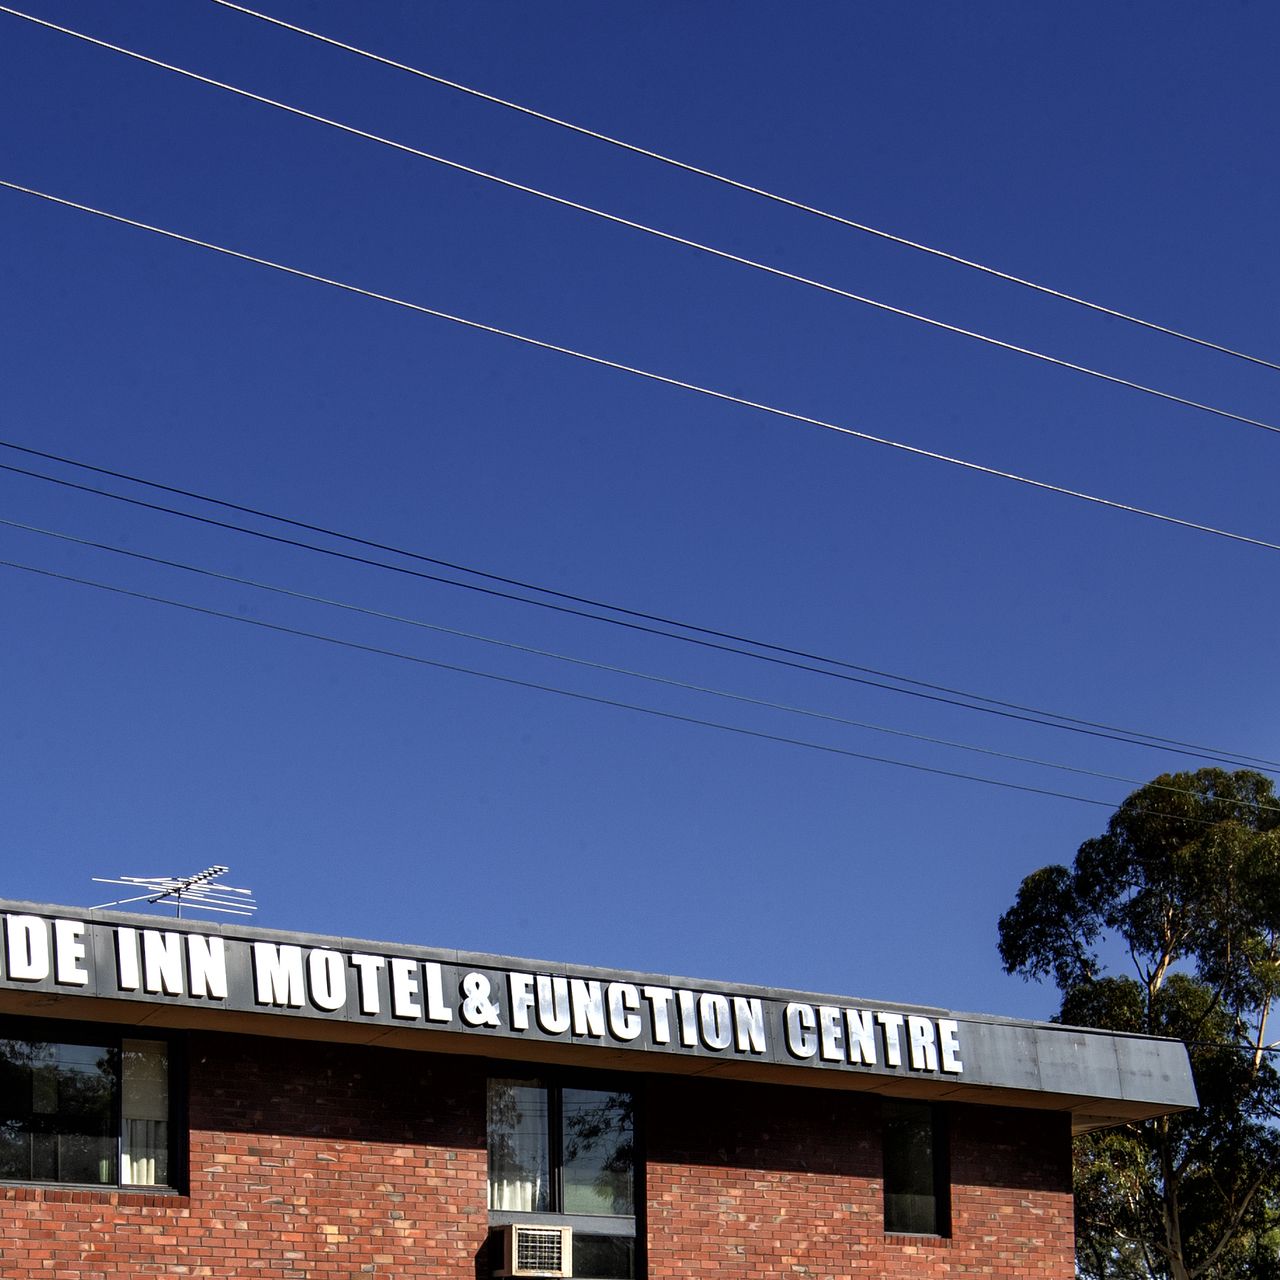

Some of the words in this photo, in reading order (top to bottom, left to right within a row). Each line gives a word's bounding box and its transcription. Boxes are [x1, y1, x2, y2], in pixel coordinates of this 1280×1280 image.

[117, 926, 227, 1000] INN
[253, 942, 453, 1023] MOTEL
[459, 970, 501, 1027] &
[508, 972, 768, 1053] FUNCTION
[782, 1001, 964, 1074] CENTRE
